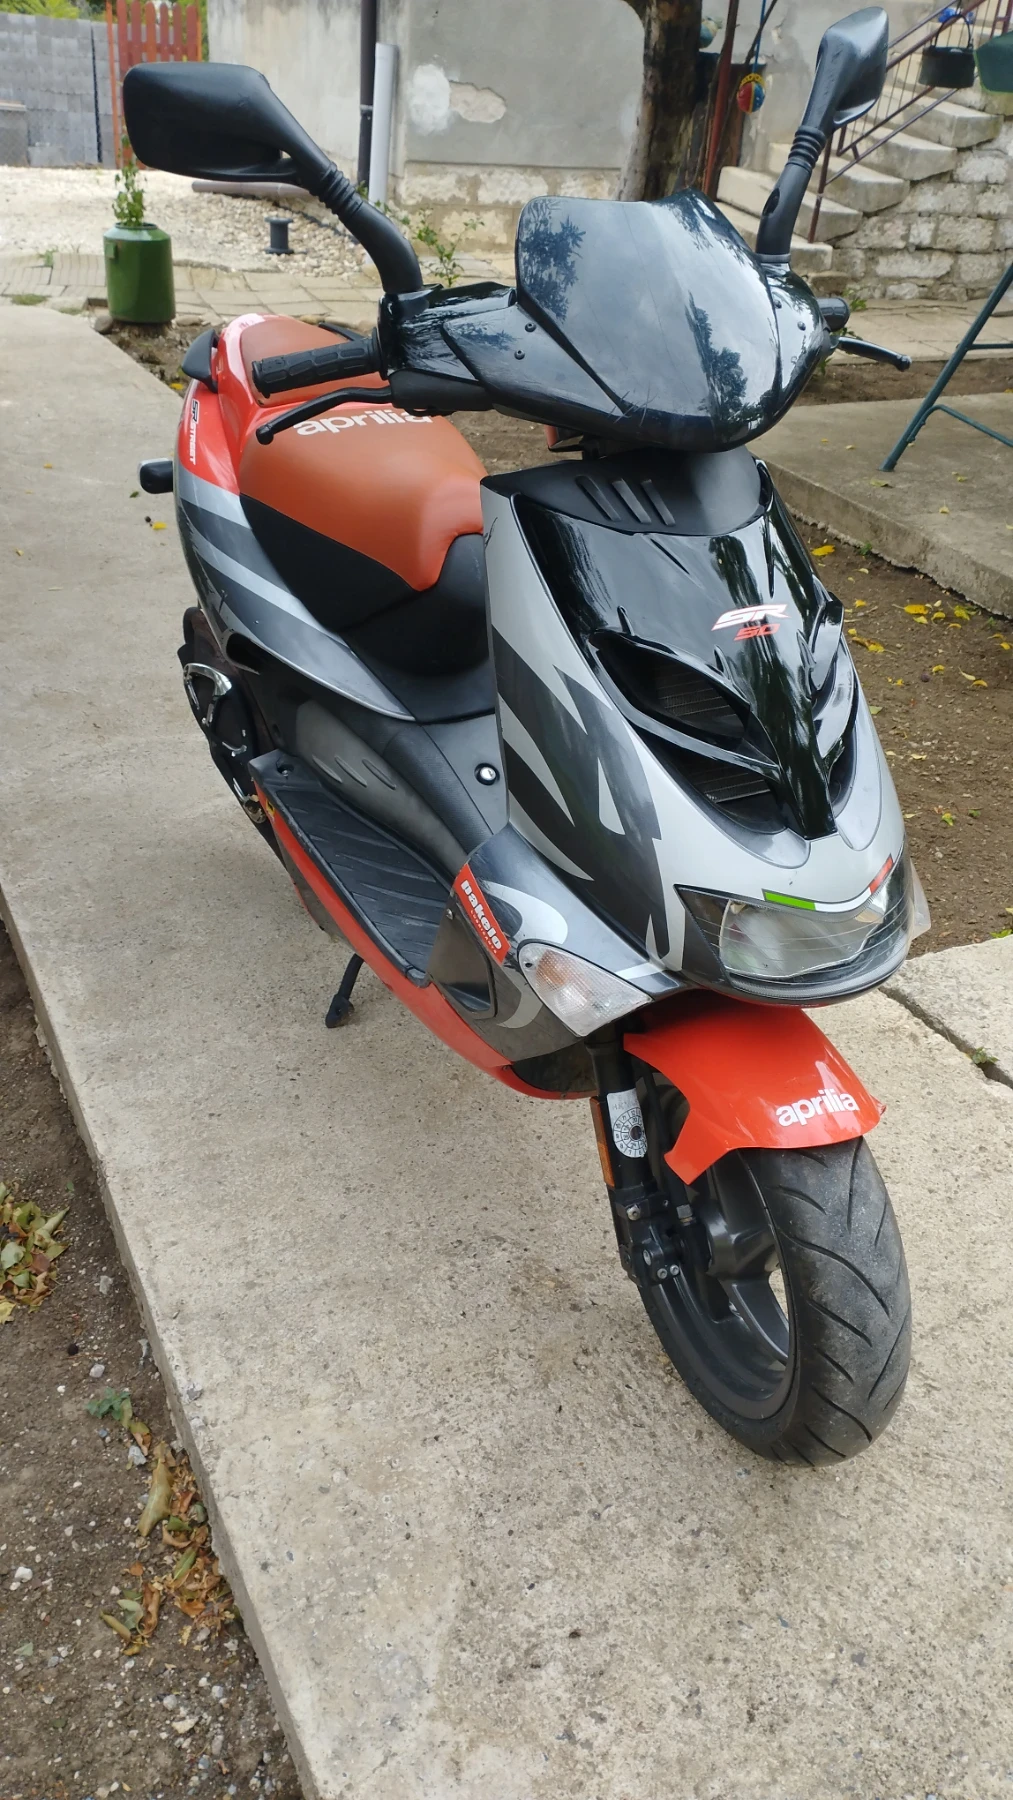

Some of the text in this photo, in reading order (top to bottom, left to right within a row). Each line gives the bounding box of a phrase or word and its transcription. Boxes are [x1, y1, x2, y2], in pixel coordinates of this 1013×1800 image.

[191, 399, 200, 423] SR
[293, 409, 433, 436] aprilia
[711, 604, 791, 631] SR
[734, 623, 781, 641] 50
[460, 879, 502, 950] pakelo
[775, 1088, 860, 1127] aprilia
